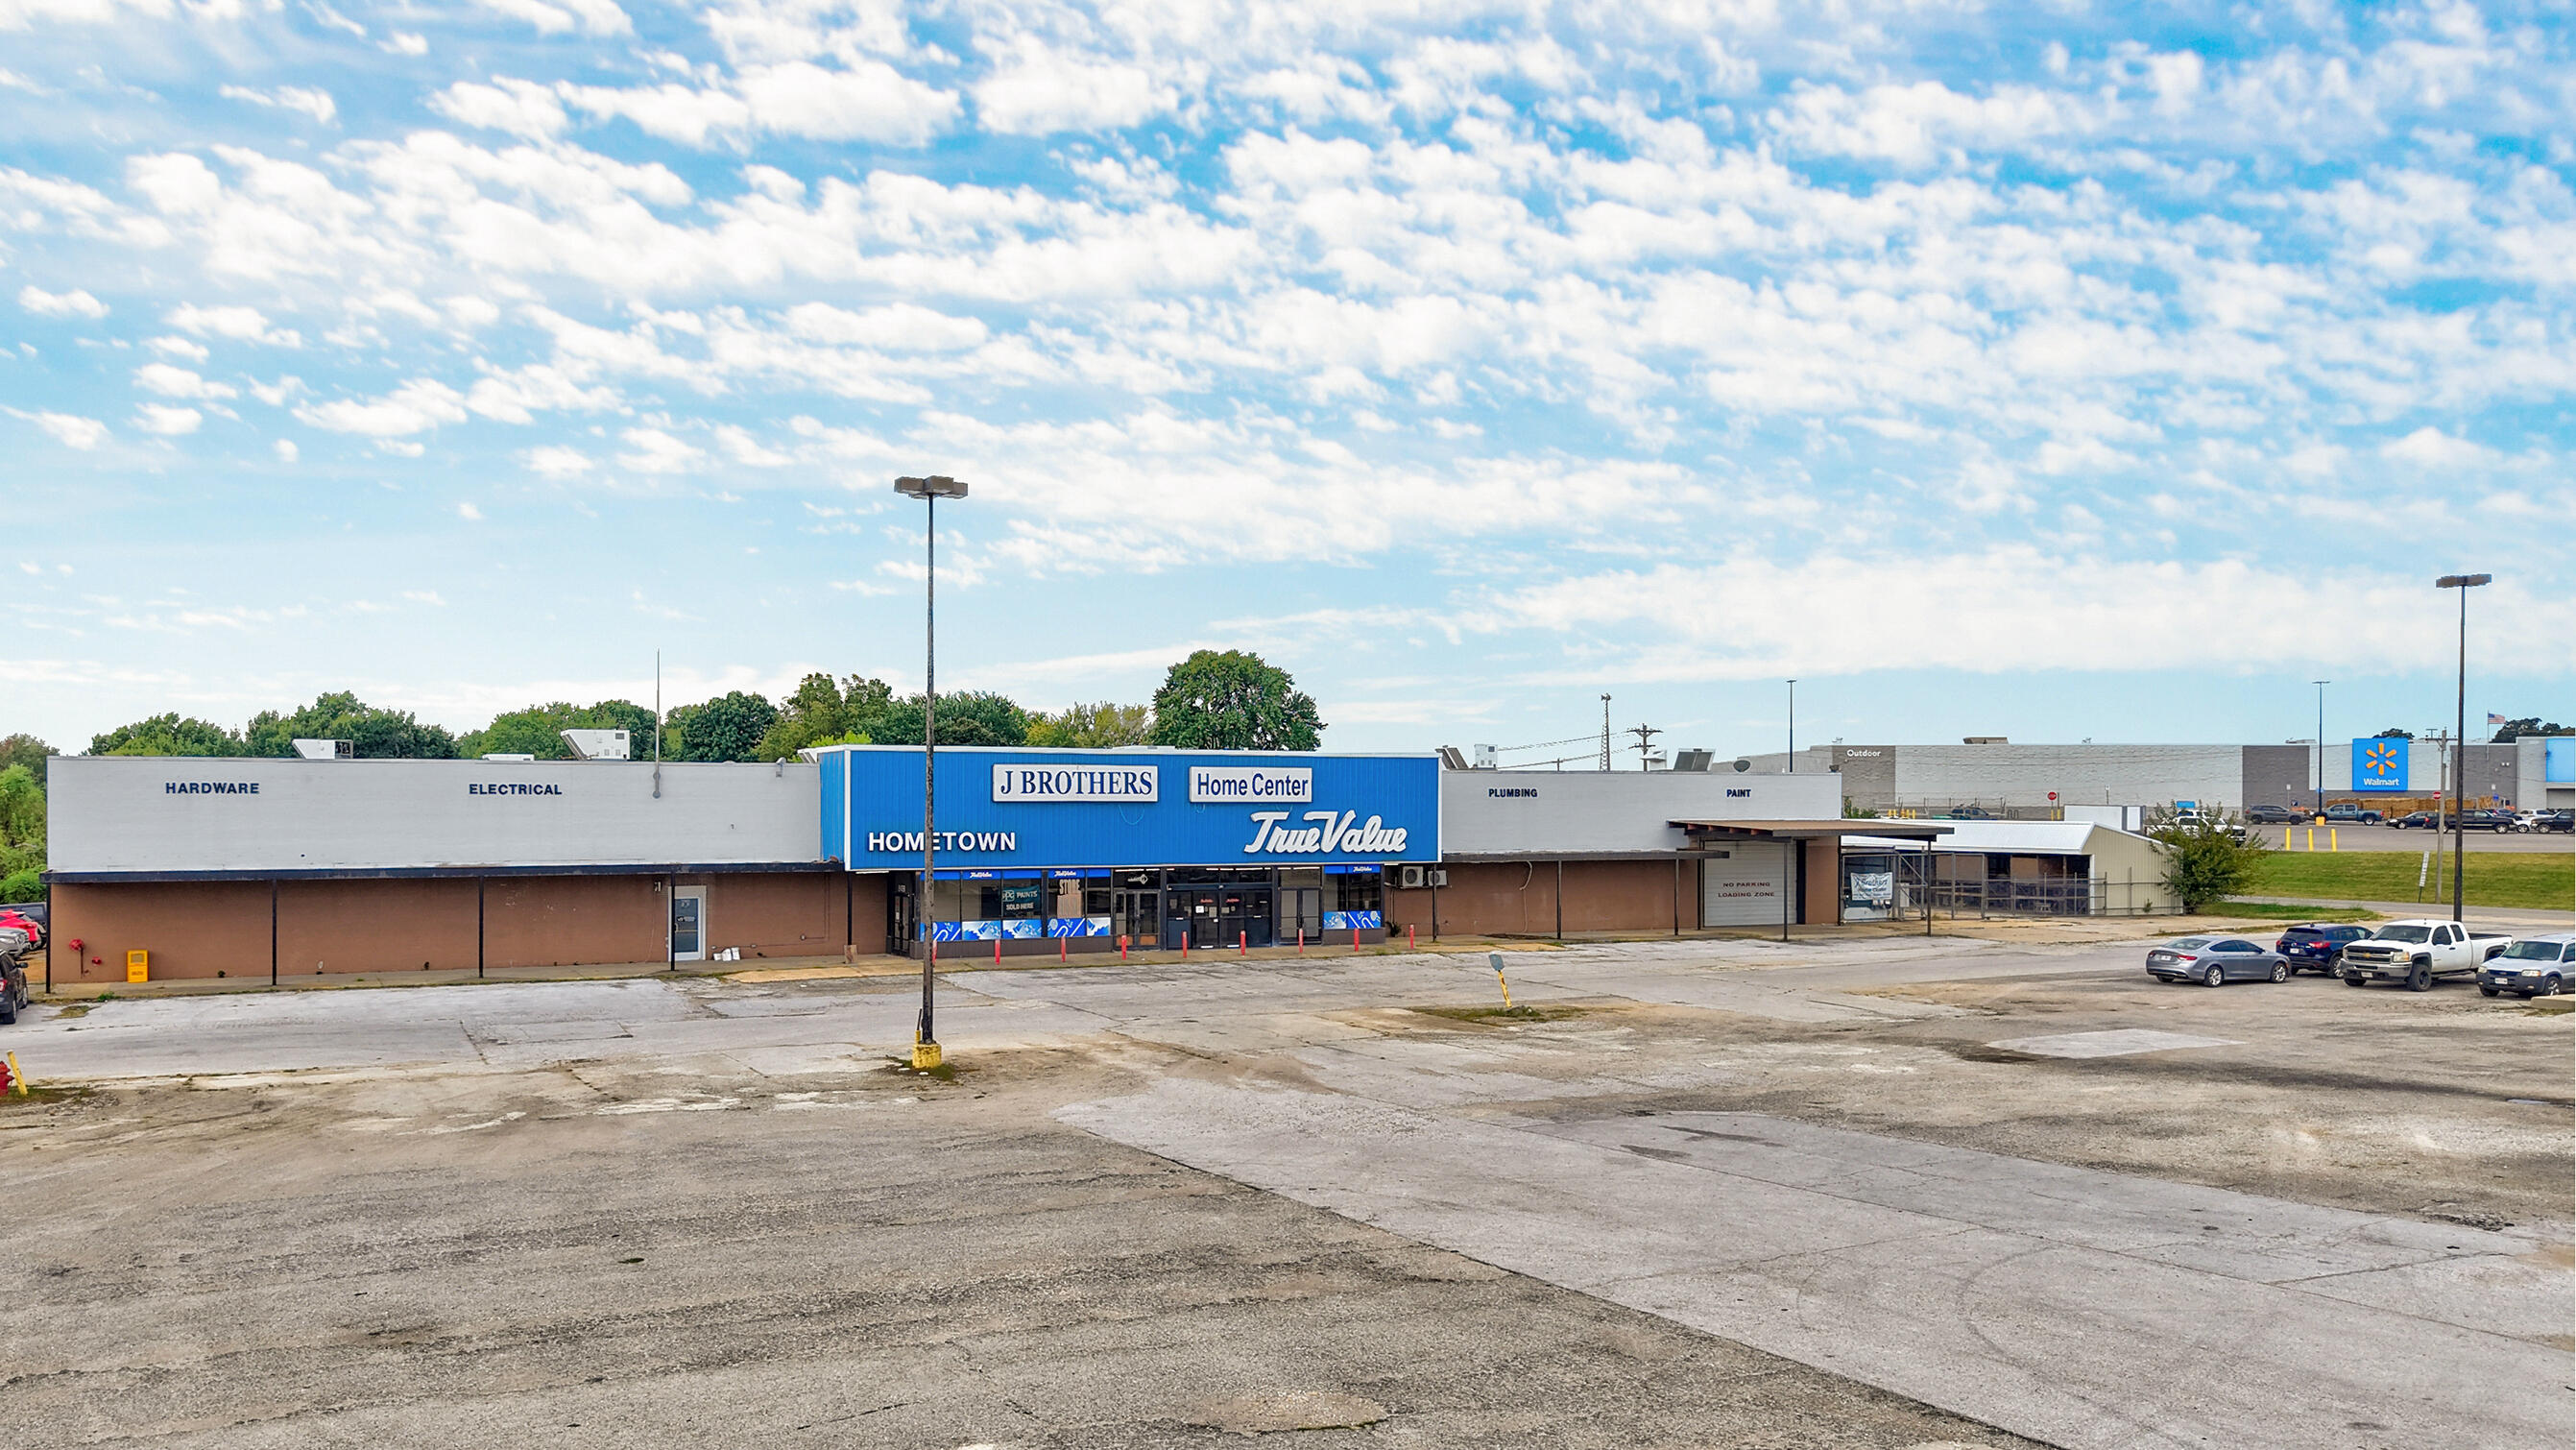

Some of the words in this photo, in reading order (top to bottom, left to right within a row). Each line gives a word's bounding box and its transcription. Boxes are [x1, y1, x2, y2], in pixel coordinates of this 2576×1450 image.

[1000, 770, 1014, 795] J
[1020, 770, 1152, 795] BROTHERS
[1197, 773, 1248, 796] Home
[1252, 773, 1308, 796] Center
[2363, 778, 2399, 786] Walmart
[165, 782, 260, 794] HARDWARE
[469, 784, 563, 795] ELECTRICAL
[1488, 788, 1538, 798] PLUMBING
[1726, 788, 1752, 798] PAINT
[868, 832, 1016, 852] HOMETOWN
